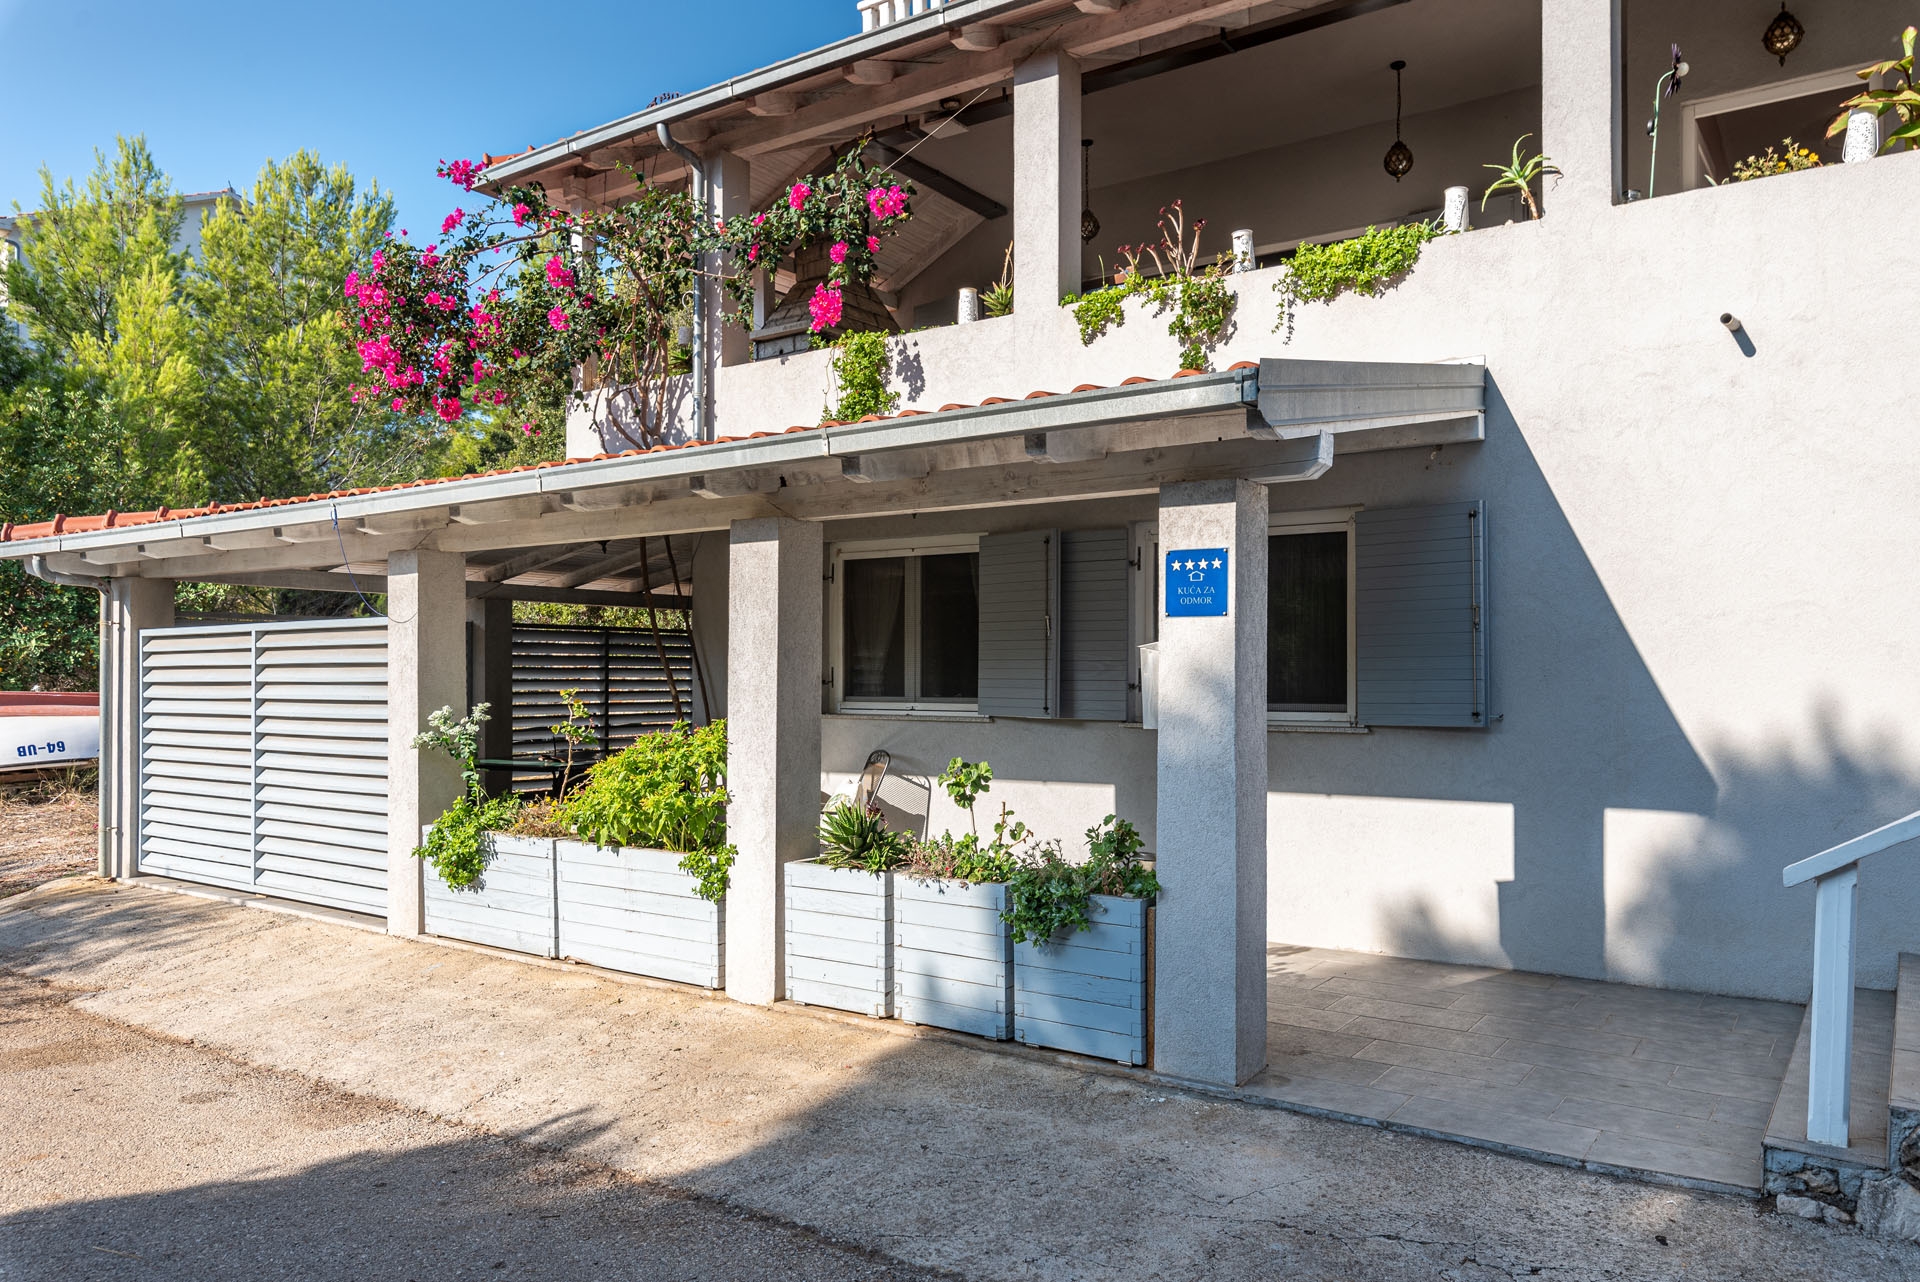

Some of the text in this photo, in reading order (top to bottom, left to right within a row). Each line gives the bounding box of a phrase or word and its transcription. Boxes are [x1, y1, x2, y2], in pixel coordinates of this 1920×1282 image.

[1177, 585, 1215, 595] KUĆA ZA
[1180, 597, 1213, 605] ODMOR
[17, 740, 66, 757] 64-UB
